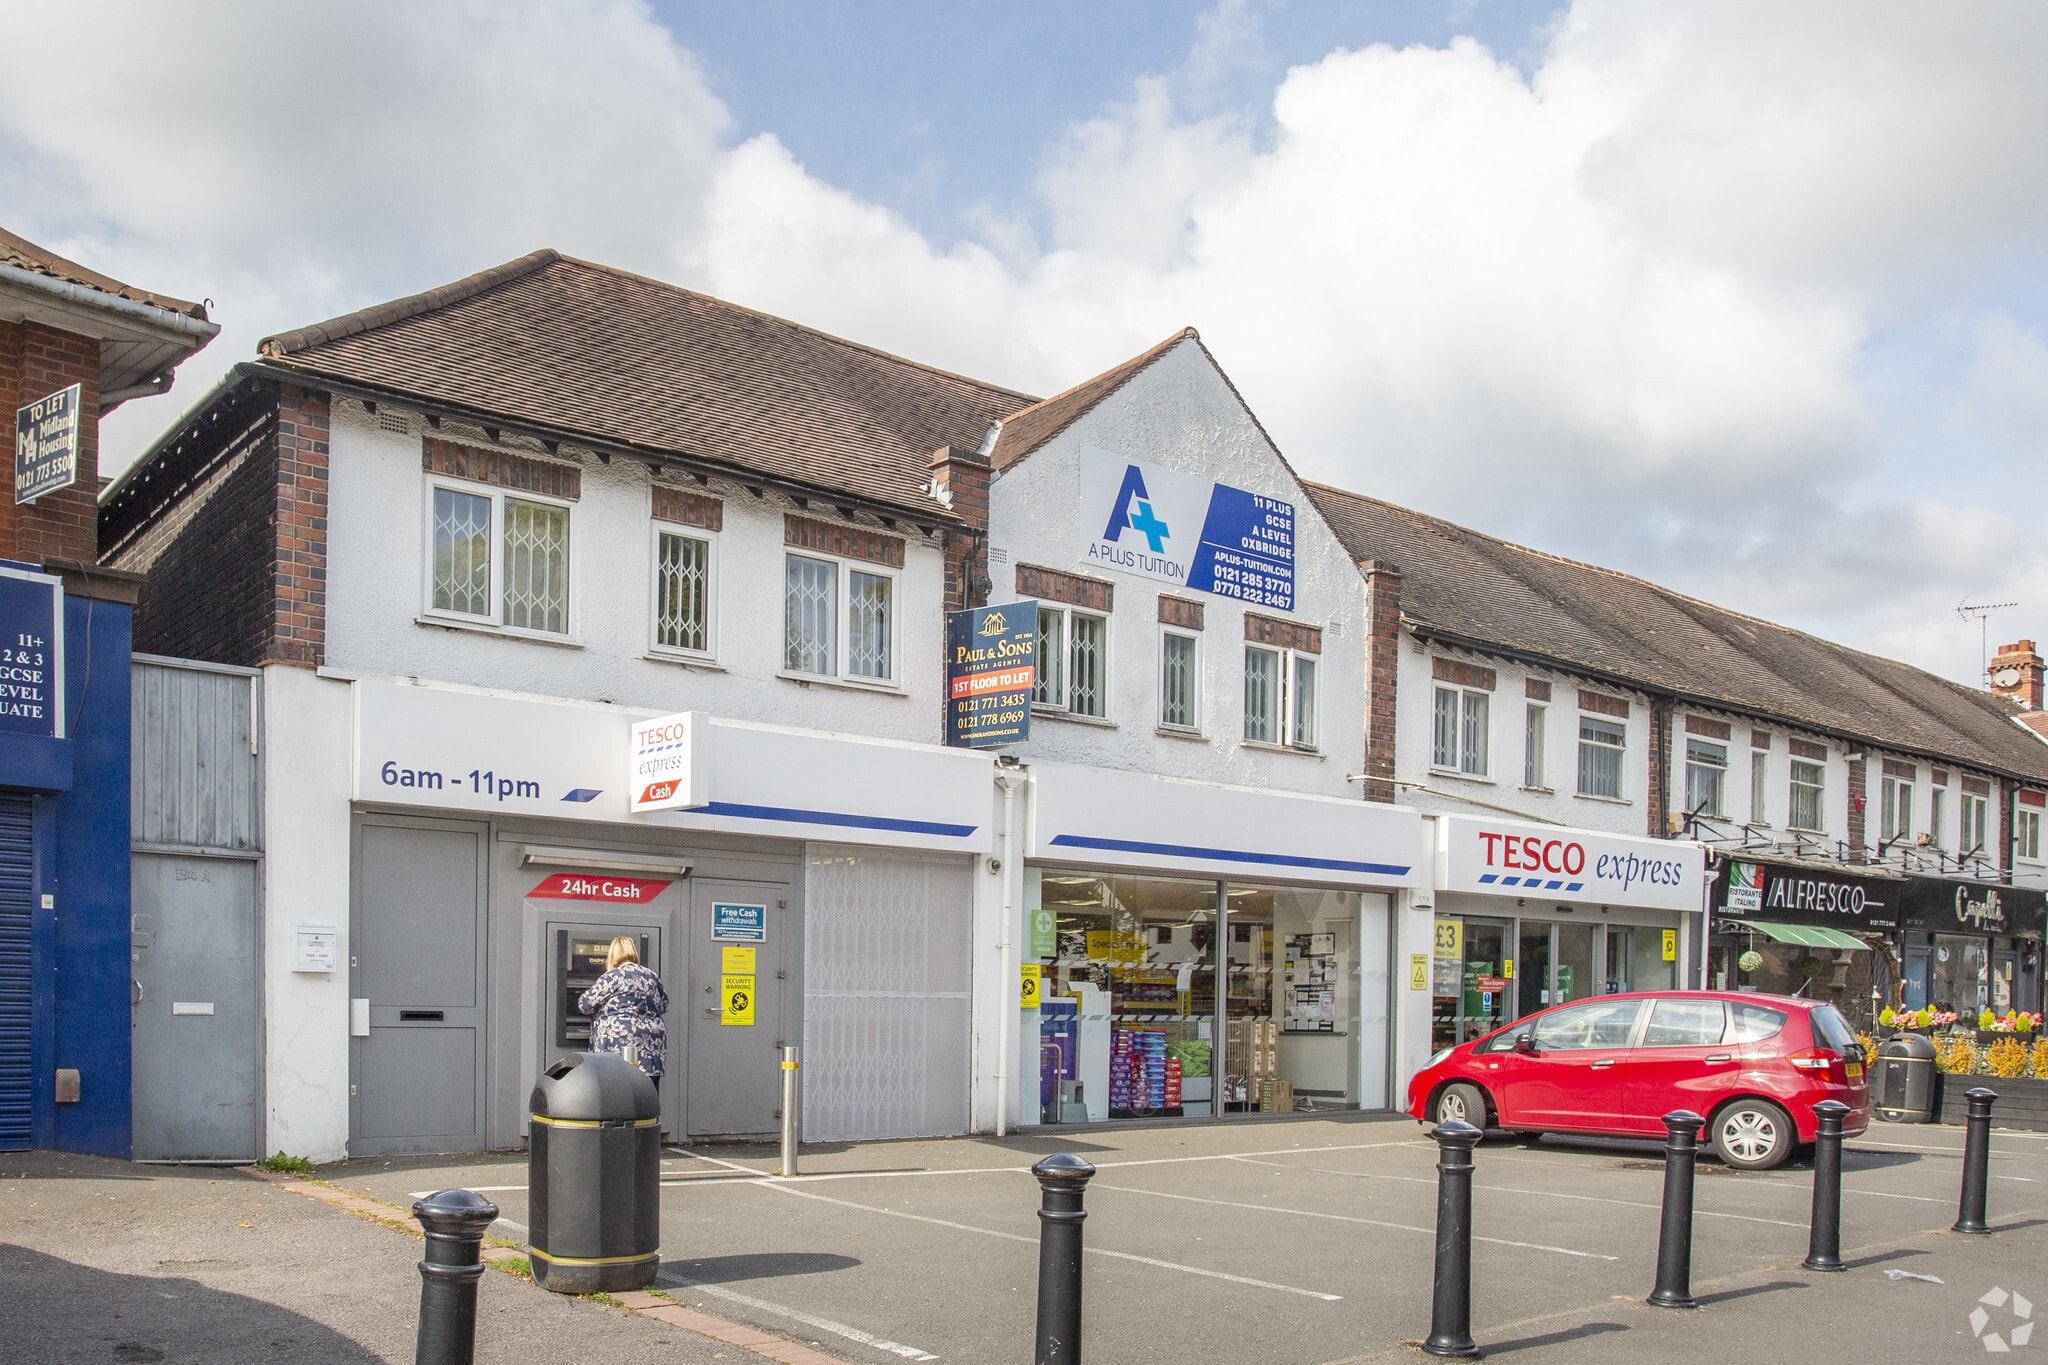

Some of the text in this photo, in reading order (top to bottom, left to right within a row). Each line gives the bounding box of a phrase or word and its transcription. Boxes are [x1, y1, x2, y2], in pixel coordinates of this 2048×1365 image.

[30, 393, 66, 423] TO LET
[40, 409, 75, 440] Midland
[39, 433, 74, 459] Housing
[17, 454, 74, 490] 0121 773 5500
[1254, 497, 1292, 516] 11 PLUS
[1265, 514, 1292, 531] GCSE
[1252, 525, 1292, 546] A LEVEL
[1088, 542, 1185, 580] A PLUS TUITION
[1241, 537, 1292, 561] OXBRIDGE
[1214, 551, 1292, 580] APLUS-TUITION.COM
[1214, 565, 1292, 595] 0121 285 3770
[1213, 580, 1292, 610] 0778 222 2467
[18, 633, 44, 648] 11+
[956, 639, 1033, 664] PAUL & SONS
[3, 648, 43, 666] 2 & 3
[965, 658, 1021, 672] ESTATE AGENTS
[0, 666, 43, 684] GCSE
[954, 671, 1030, 693] 1ST FLOOR TO LET
[958, 693, 1025, 713] 0121 771 3435
[957, 710, 1025, 729] 0121 778 6969
[638, 723, 684, 747] TESCO
[639, 753, 682, 778] express
[381, 760, 443, 790] 6am
[469, 769, 540, 801] 11pm
[649, 782, 672, 800] Cash
[1478, 831, 1683, 891] TESCO express
[561, 879, 640, 899] 24hr Cash
[1730, 887, 1763, 899] RISTORANTE
[1766, 877, 1865, 915] ALFRESCO
[721, 907, 758, 918] Free Cash
[721, 916, 757, 925] withdrawals
[1436, 924, 1455, 949] £3
